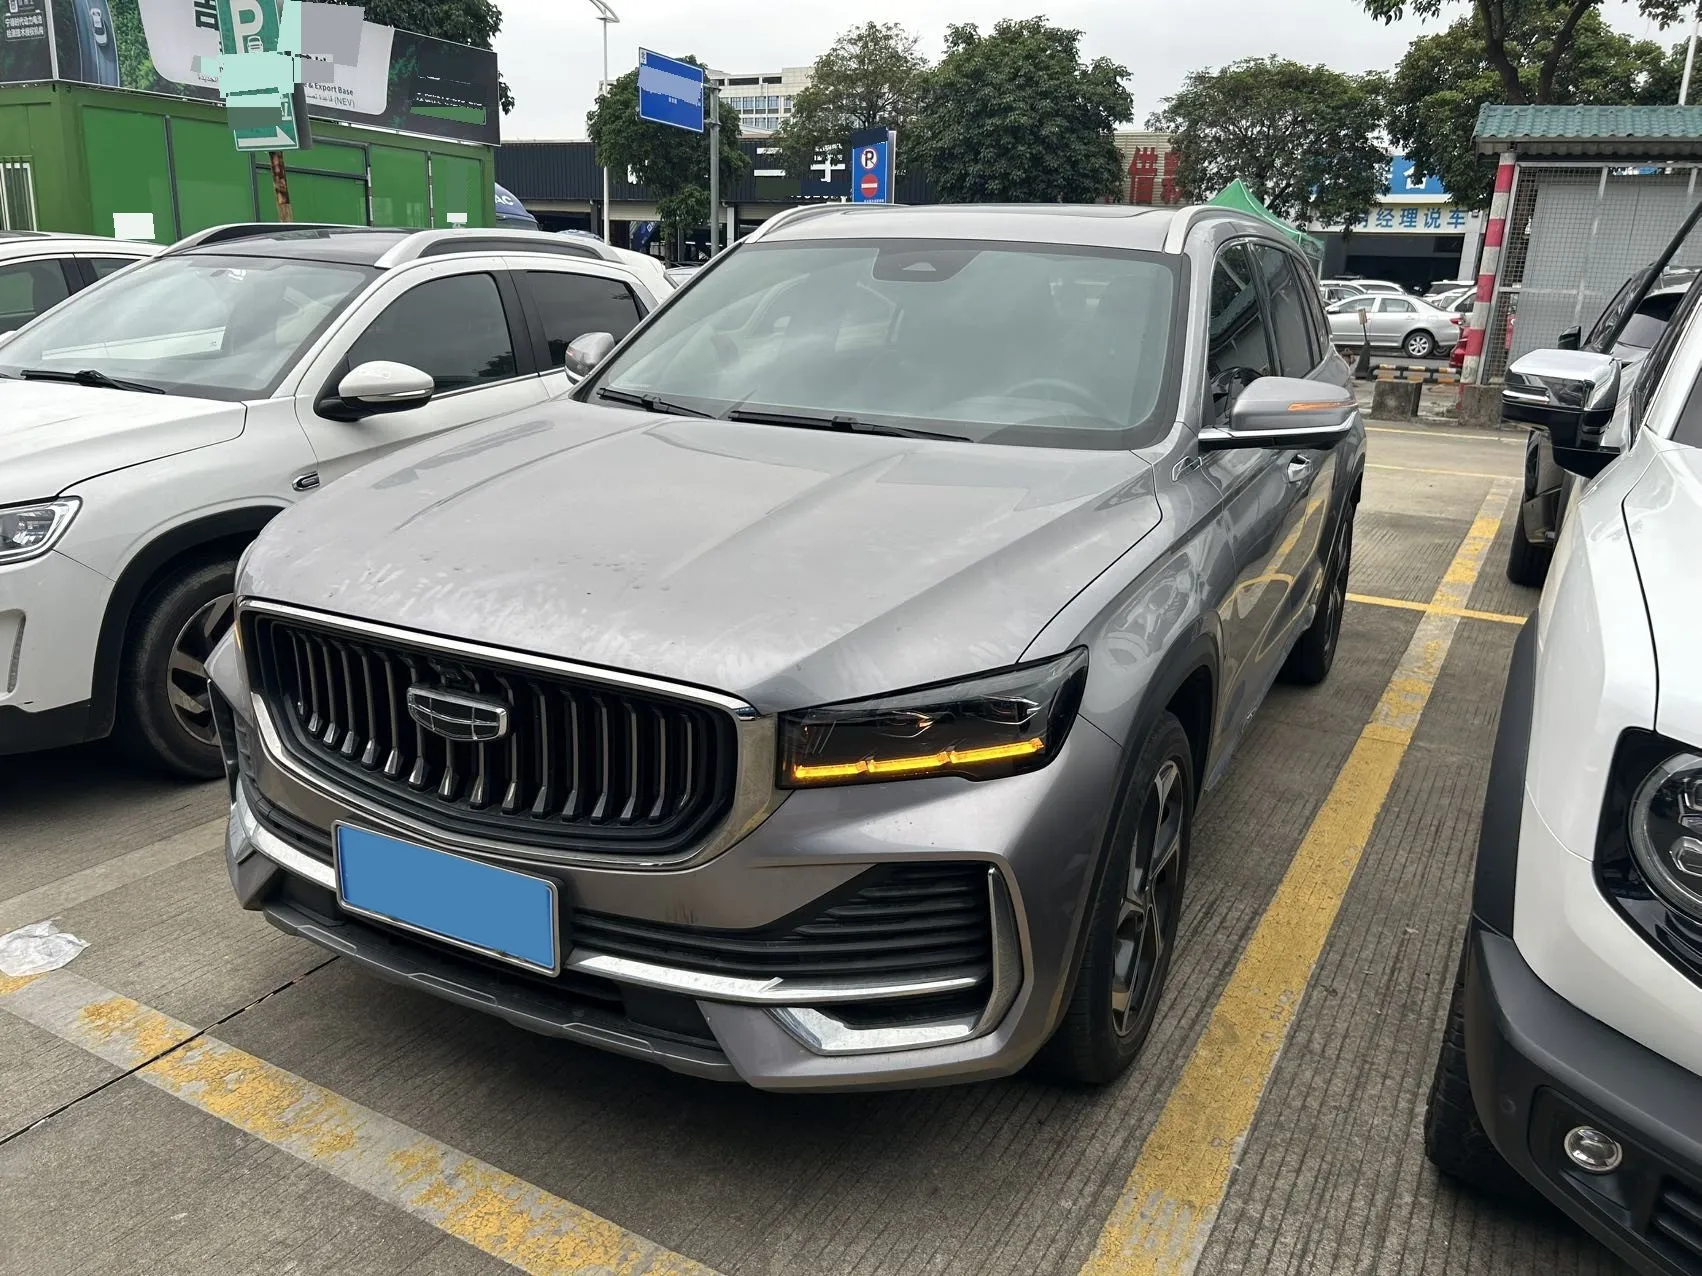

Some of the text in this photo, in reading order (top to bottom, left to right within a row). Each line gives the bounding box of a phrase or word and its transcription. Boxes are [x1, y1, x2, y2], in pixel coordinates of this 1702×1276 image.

[229, 0, 263, 54] P
[314, 83, 337, 93] Export
[338, 87, 354, 96] Base
[334, 96, 355, 108] (NEV)
